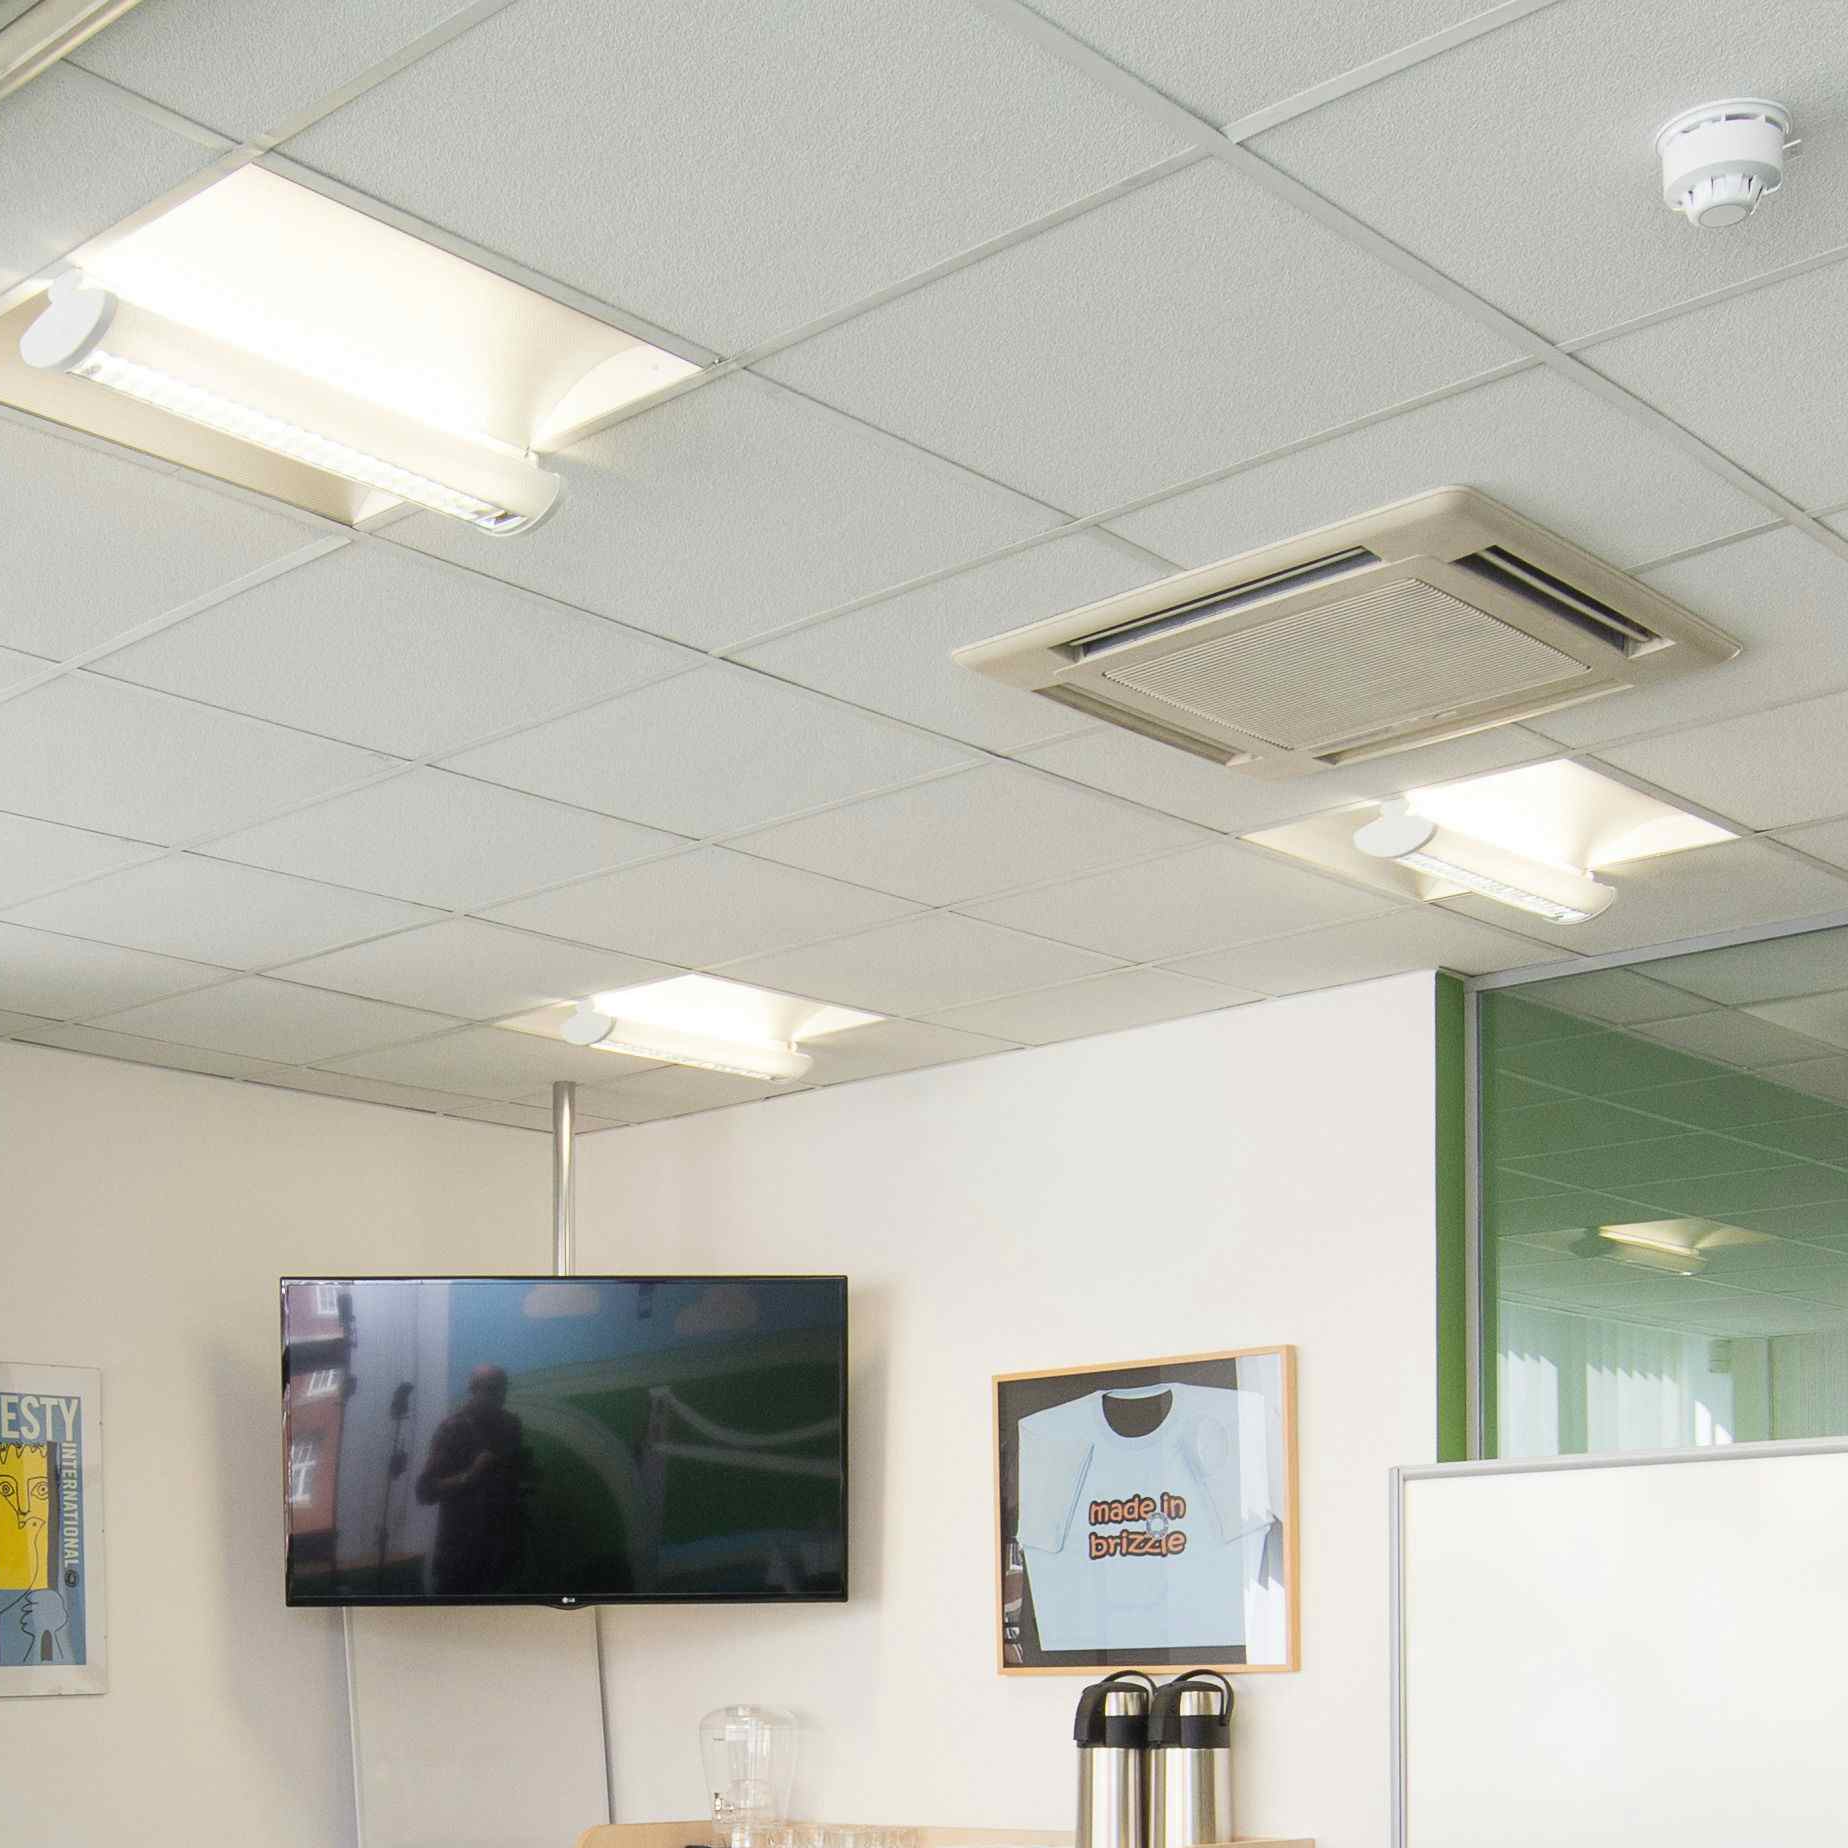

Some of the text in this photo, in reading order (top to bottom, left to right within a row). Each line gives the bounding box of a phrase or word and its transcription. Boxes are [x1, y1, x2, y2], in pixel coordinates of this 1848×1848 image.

[61, 1442, 79, 1567] INTERNATIONAL
[1089, 1492, 1186, 1525] made in
